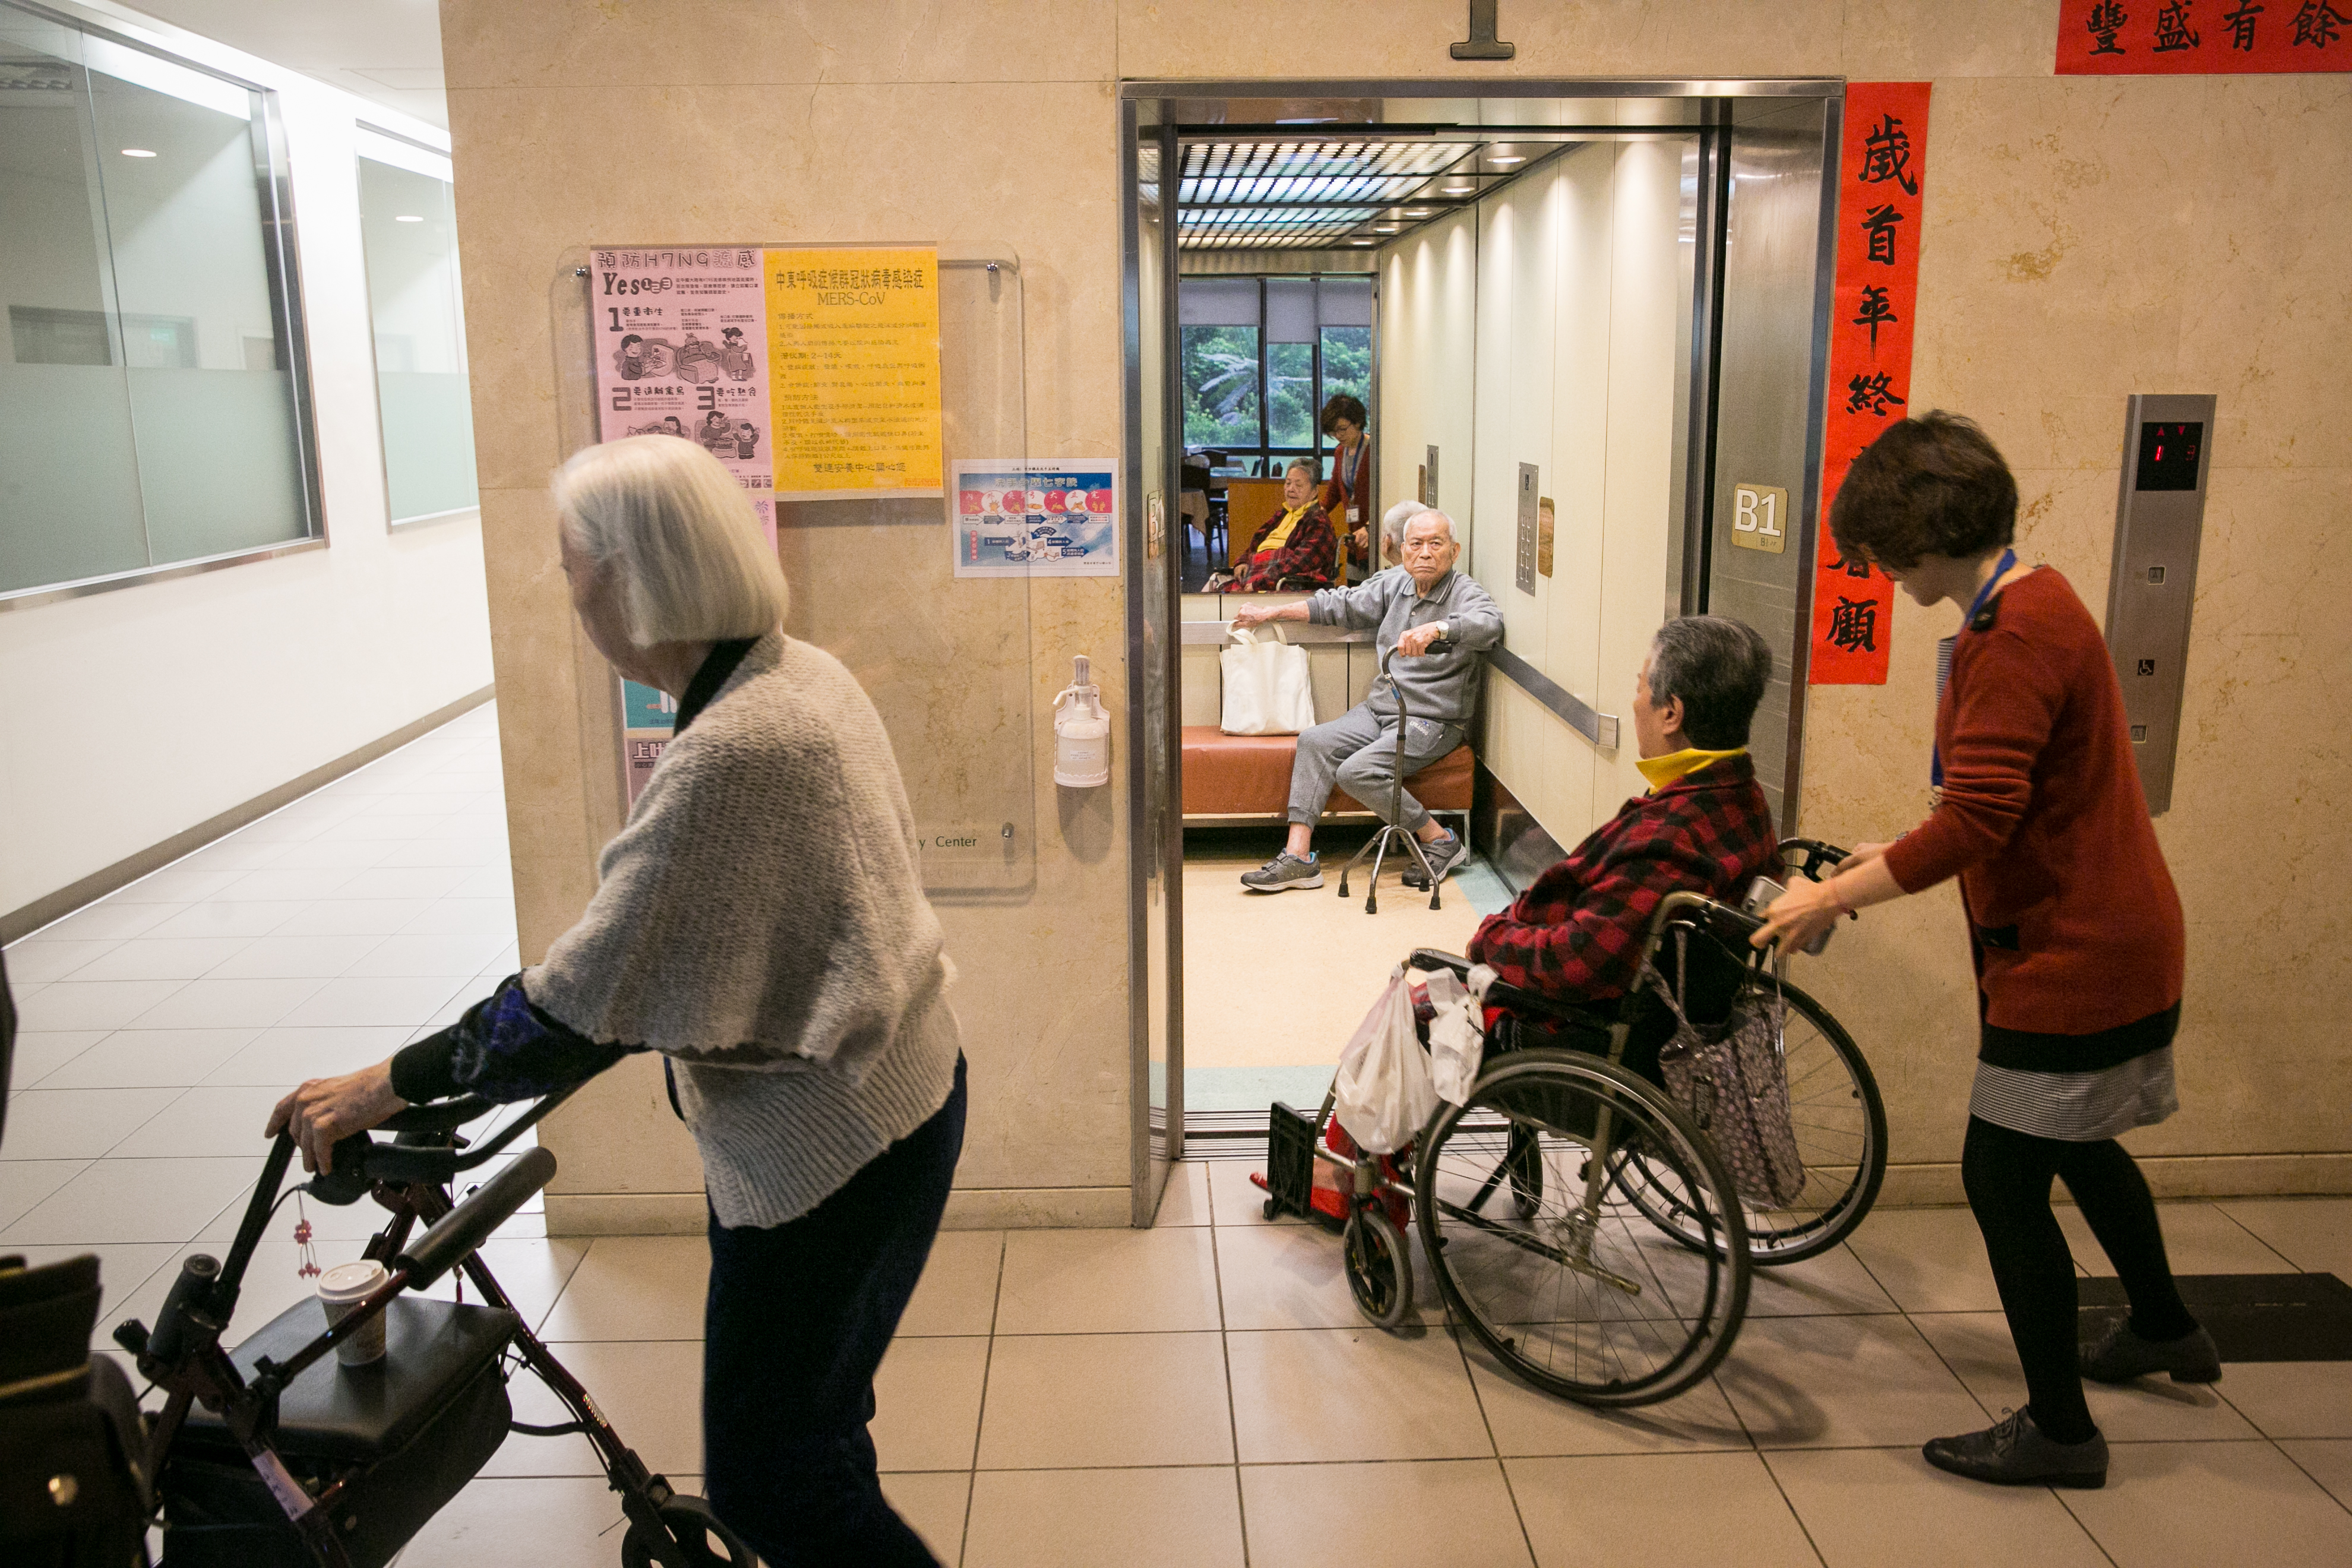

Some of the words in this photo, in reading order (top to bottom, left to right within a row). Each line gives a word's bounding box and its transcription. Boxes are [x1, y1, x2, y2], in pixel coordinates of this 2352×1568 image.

[2086, 0, 2352, 55] 豐盛有餘
[598, 249, 755, 268] 預防H7N9流感
[776, 268, 924, 290] 中東呼吸症候群冠狀病毒感染症
[817, 292, 886, 305] MERS-CoV
[608, 307, 624, 331] 1
[716, 387, 756, 396] 要吃熟食
[1826, 114, 1917, 652] 歲首年終顧
[612, 387, 632, 410] 2
[696, 386, 715, 410] 3
[1735, 489, 1781, 537] B1
[935, 836, 977, 848] Center
